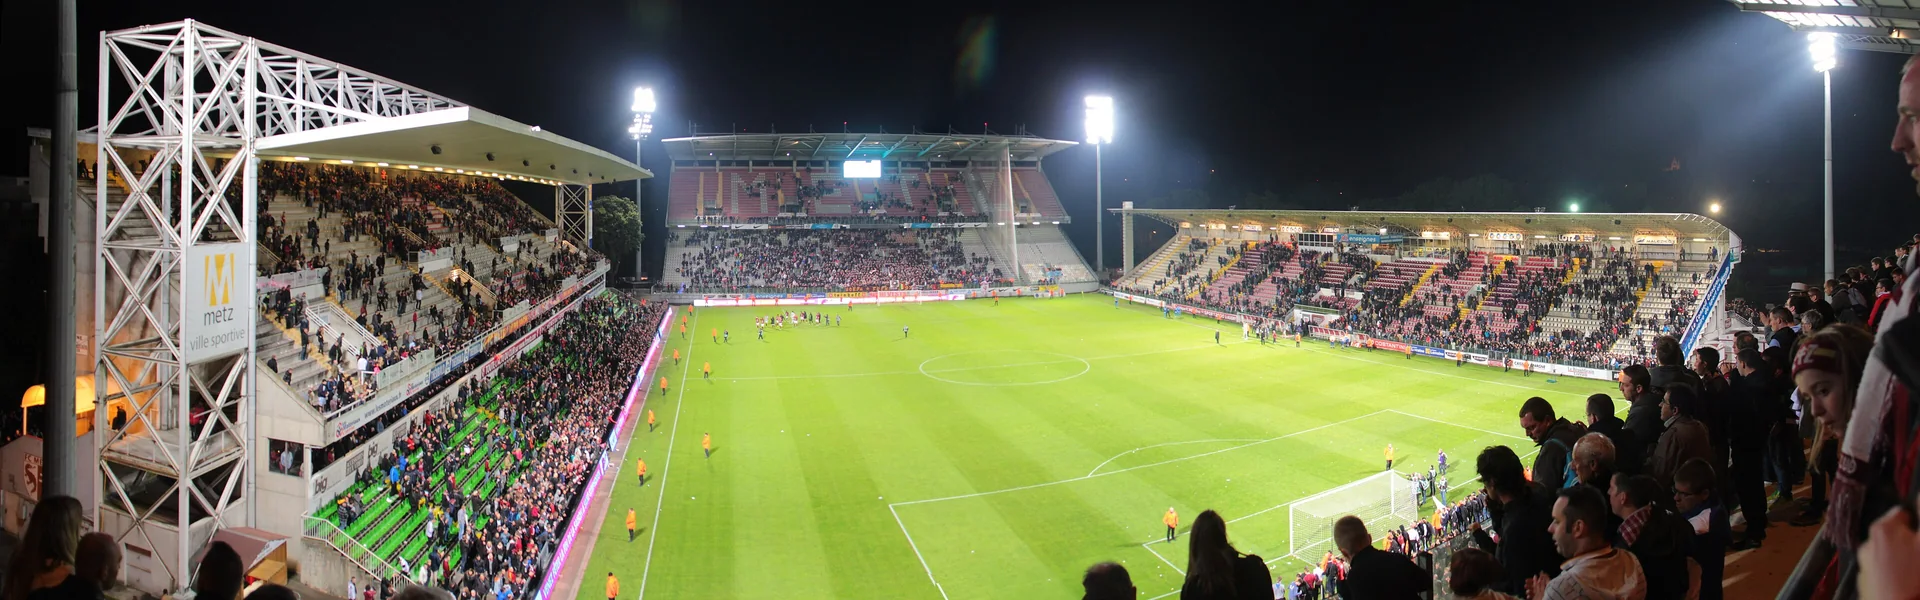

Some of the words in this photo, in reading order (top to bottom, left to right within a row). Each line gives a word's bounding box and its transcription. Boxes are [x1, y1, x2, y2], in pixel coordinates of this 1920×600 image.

[203, 307, 234, 326] metz
[190, 335, 209, 351] ville
[211, 328, 245, 348] sportive
[24, 453, 32, 462] FC
[314, 475, 328, 495] big
